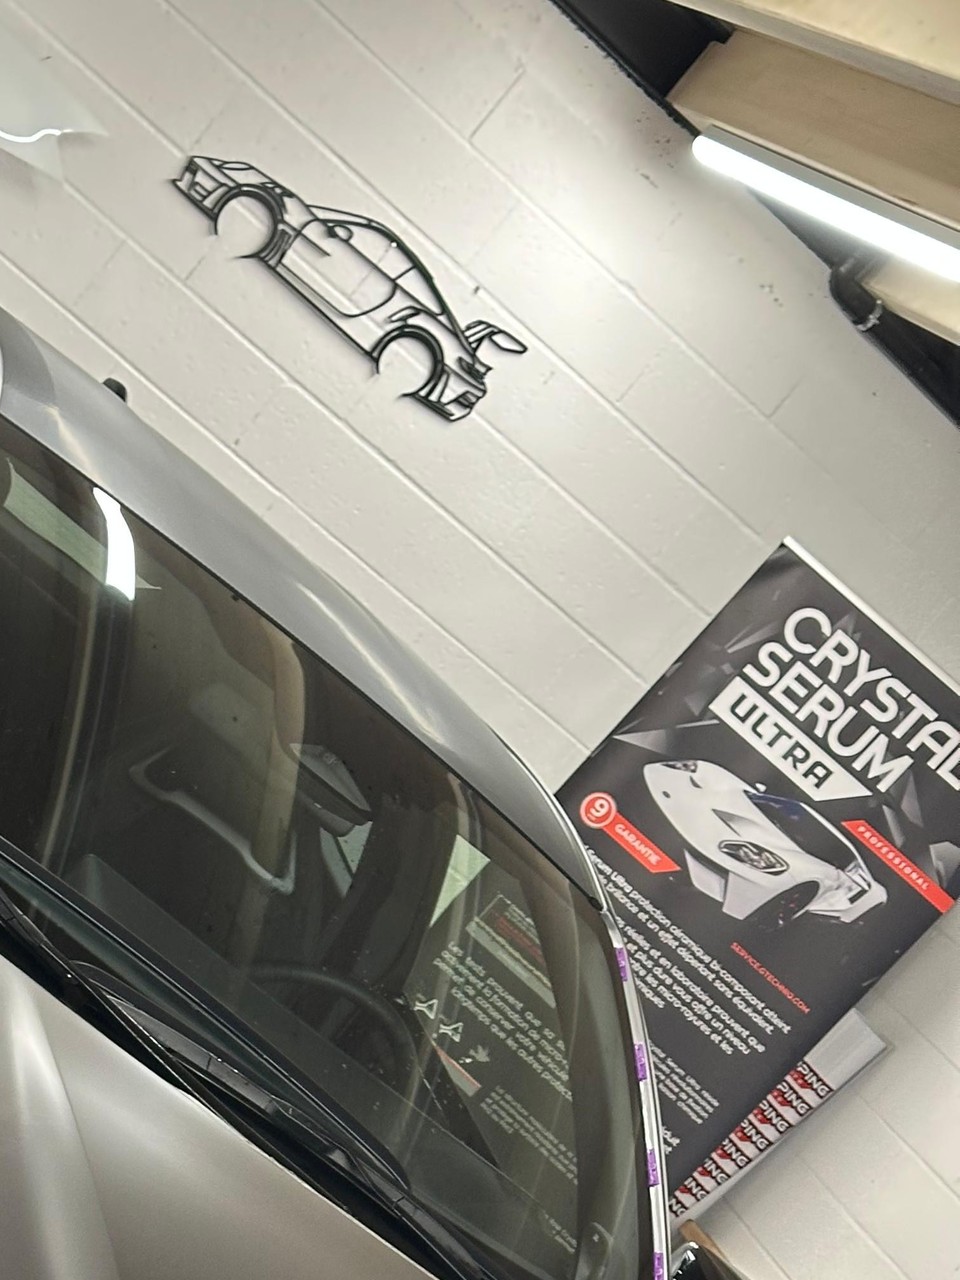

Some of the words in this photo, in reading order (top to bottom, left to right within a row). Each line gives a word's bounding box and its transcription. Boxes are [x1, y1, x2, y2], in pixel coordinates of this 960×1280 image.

[741, 641, 915, 794] SERUM
[783, 607, 960, 792] CRYSTAL
[728, 692, 834, 790] ULTRA
[591, 796, 608, 817] 9
[614, 822, 663, 866] GARANTIE
[856, 824, 931, 892] PROFESSIONAL
[604, 881, 639, 913] brillance
[636, 911, 649, 922] et
[646, 919, 659, 931] un
[657, 930, 679, 949] effet
[676, 946, 716, 981] déperlant
[712, 979, 733, 998] sans
[610, 871, 632, 892] Ultra
[628, 890, 671, 927] protection
[669, 925, 712, 963] céramique
[709, 959, 765, 1010] bi-composant
[762, 1008, 791, 1034] atteint
[463, 984, 475, 996] de
[475, 996, 515, 1030] conserver
[524, 1011, 541, 1027] que
[623, 925, 651, 950] réelles
[648, 948, 661, 959] et
[658, 957, 671, 968] en
[669, 965, 714, 1006] laboratoire
[710, 1004, 750, 1038] prouvent
[747, 1036, 765, 1052] que
[624, 942, 638, 953] et
[633, 950, 654, 968] plus
[652, 966, 673, 984] dure
[672, 982, 692, 1002] vous
[690, 1000, 712, 1020] offre
[710, 1018, 723, 1030] un
[721, 1028, 750, 1054] niveau
[644, 973, 658, 987] les
[656, 985, 712, 1035] micro-rayures
[710, 1033, 722, 1043] et
[719, 1039, 733, 1054] les
[489, 1023, 506, 1039] que
[527, 1029, 540, 1040] de
[664, 1078, 680, 1092] base
[678, 1091, 687, 1100] de
[685, 1097, 708, 1118] fixation
[676, 1100, 703, 1124] chimique
